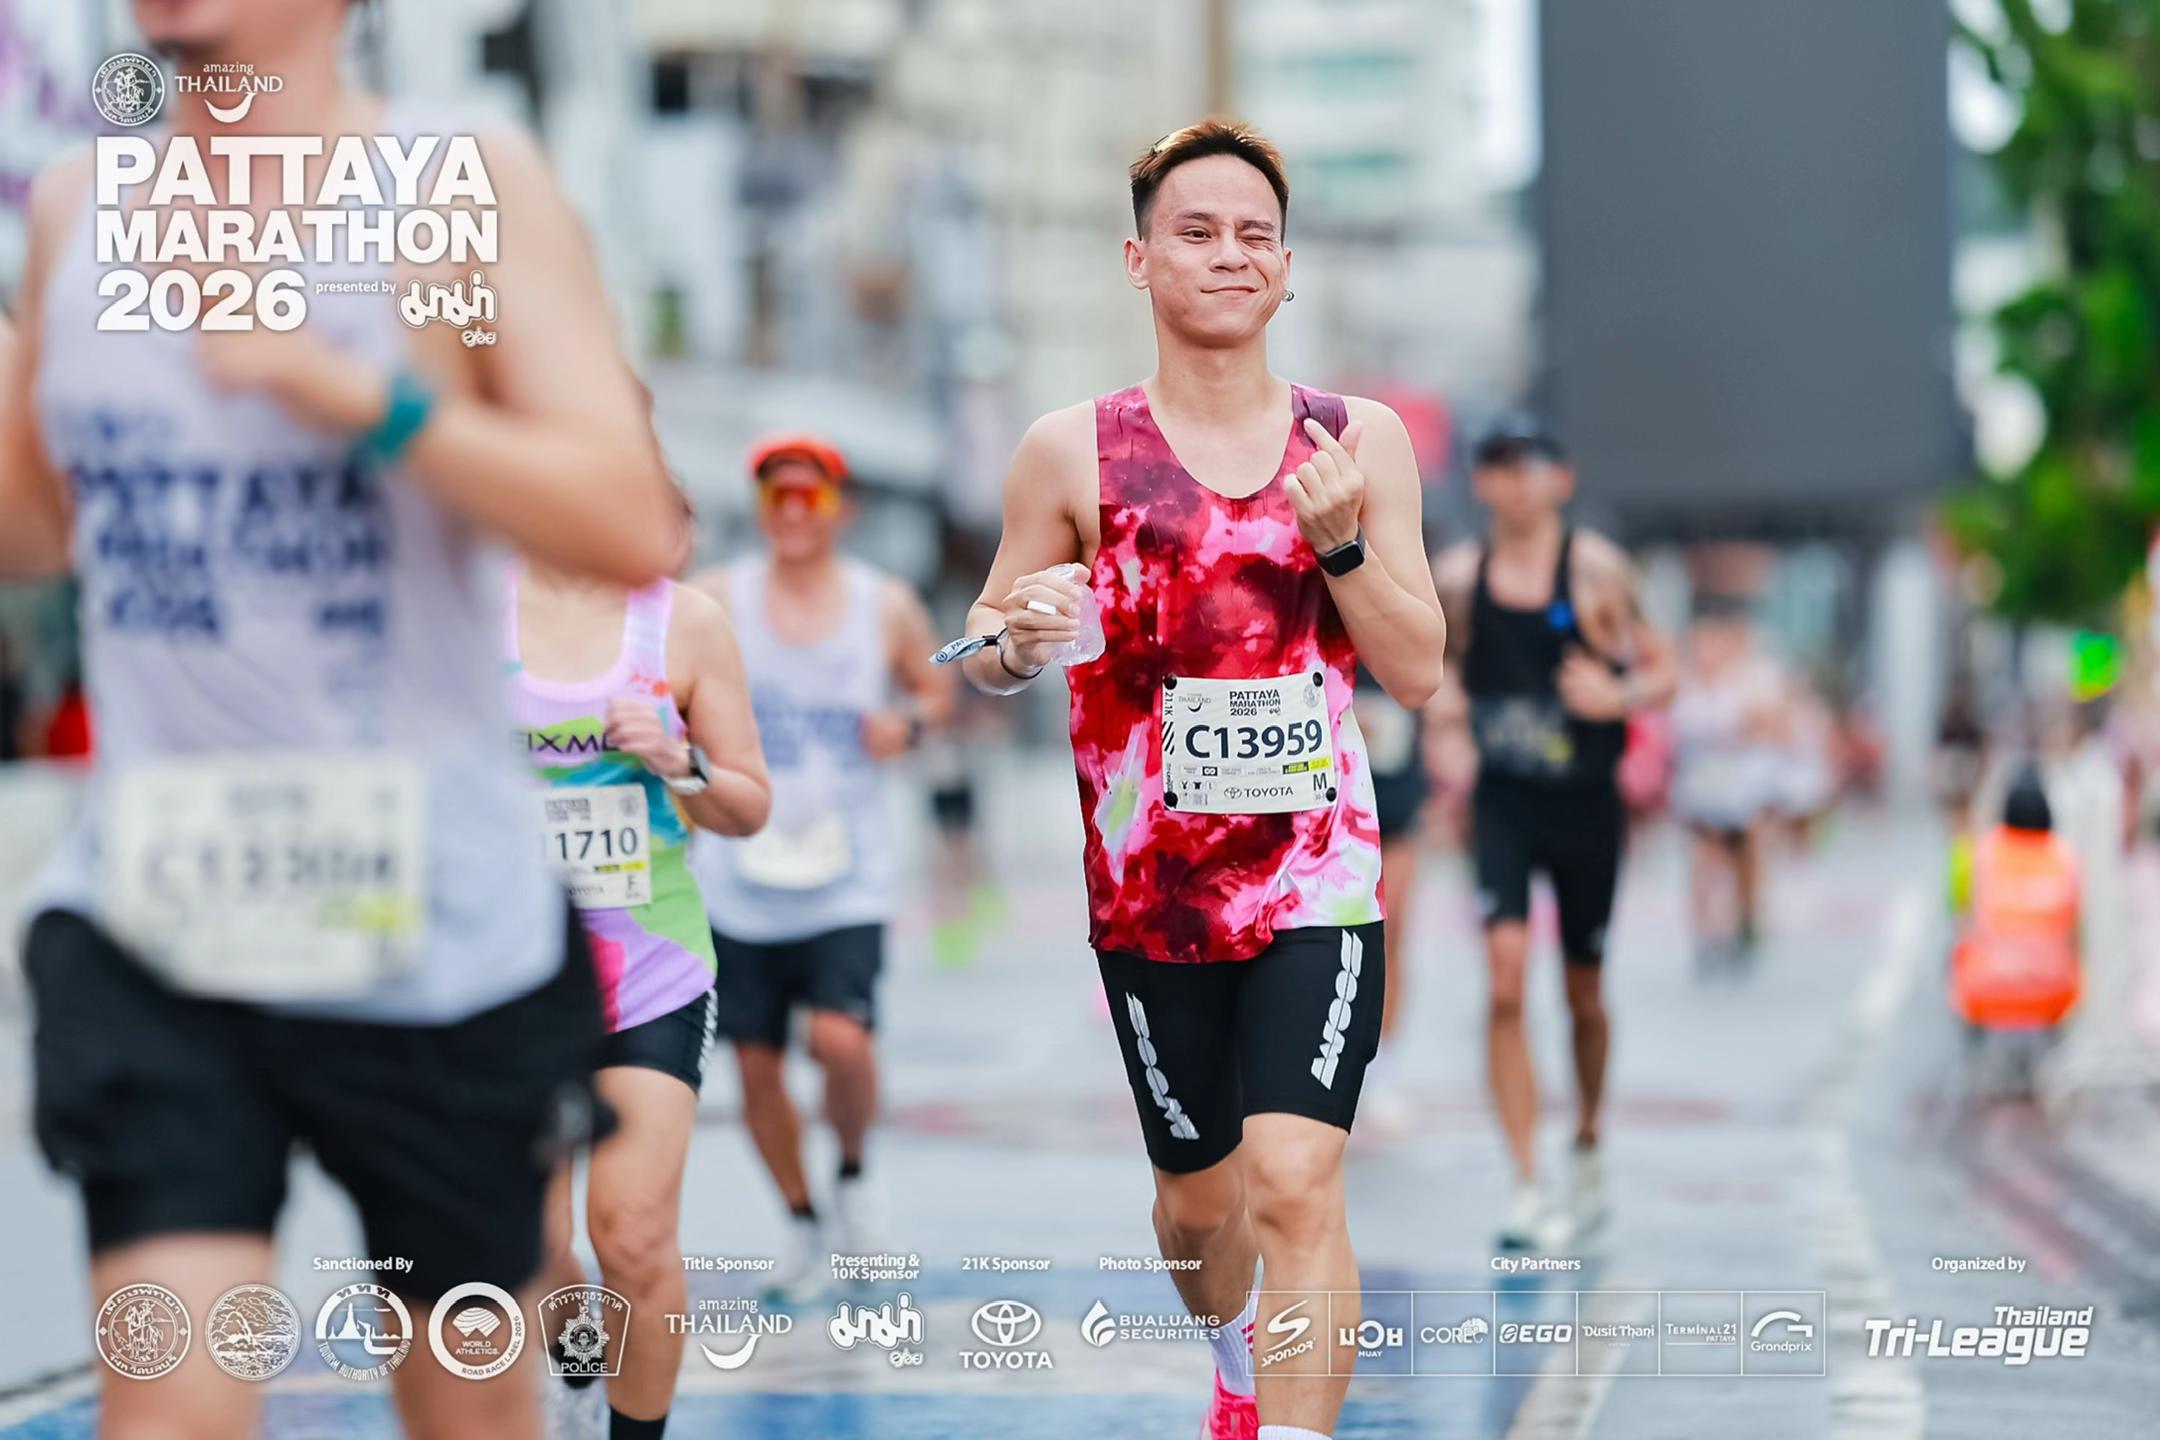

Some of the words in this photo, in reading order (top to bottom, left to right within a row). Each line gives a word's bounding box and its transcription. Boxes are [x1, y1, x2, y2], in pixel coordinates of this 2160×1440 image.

[1230, 689, 1280, 700] PATTAYA
[1165, 692, 1173, 716] 21.1K
[1230, 699, 1281, 708] MARATHON
[1230, 708, 1257, 716] 2026
[1185, 719, 1323, 759] C13959
[1313, 772, 1327, 791] M
[1244, 786, 1294, 798] TOYOTA
